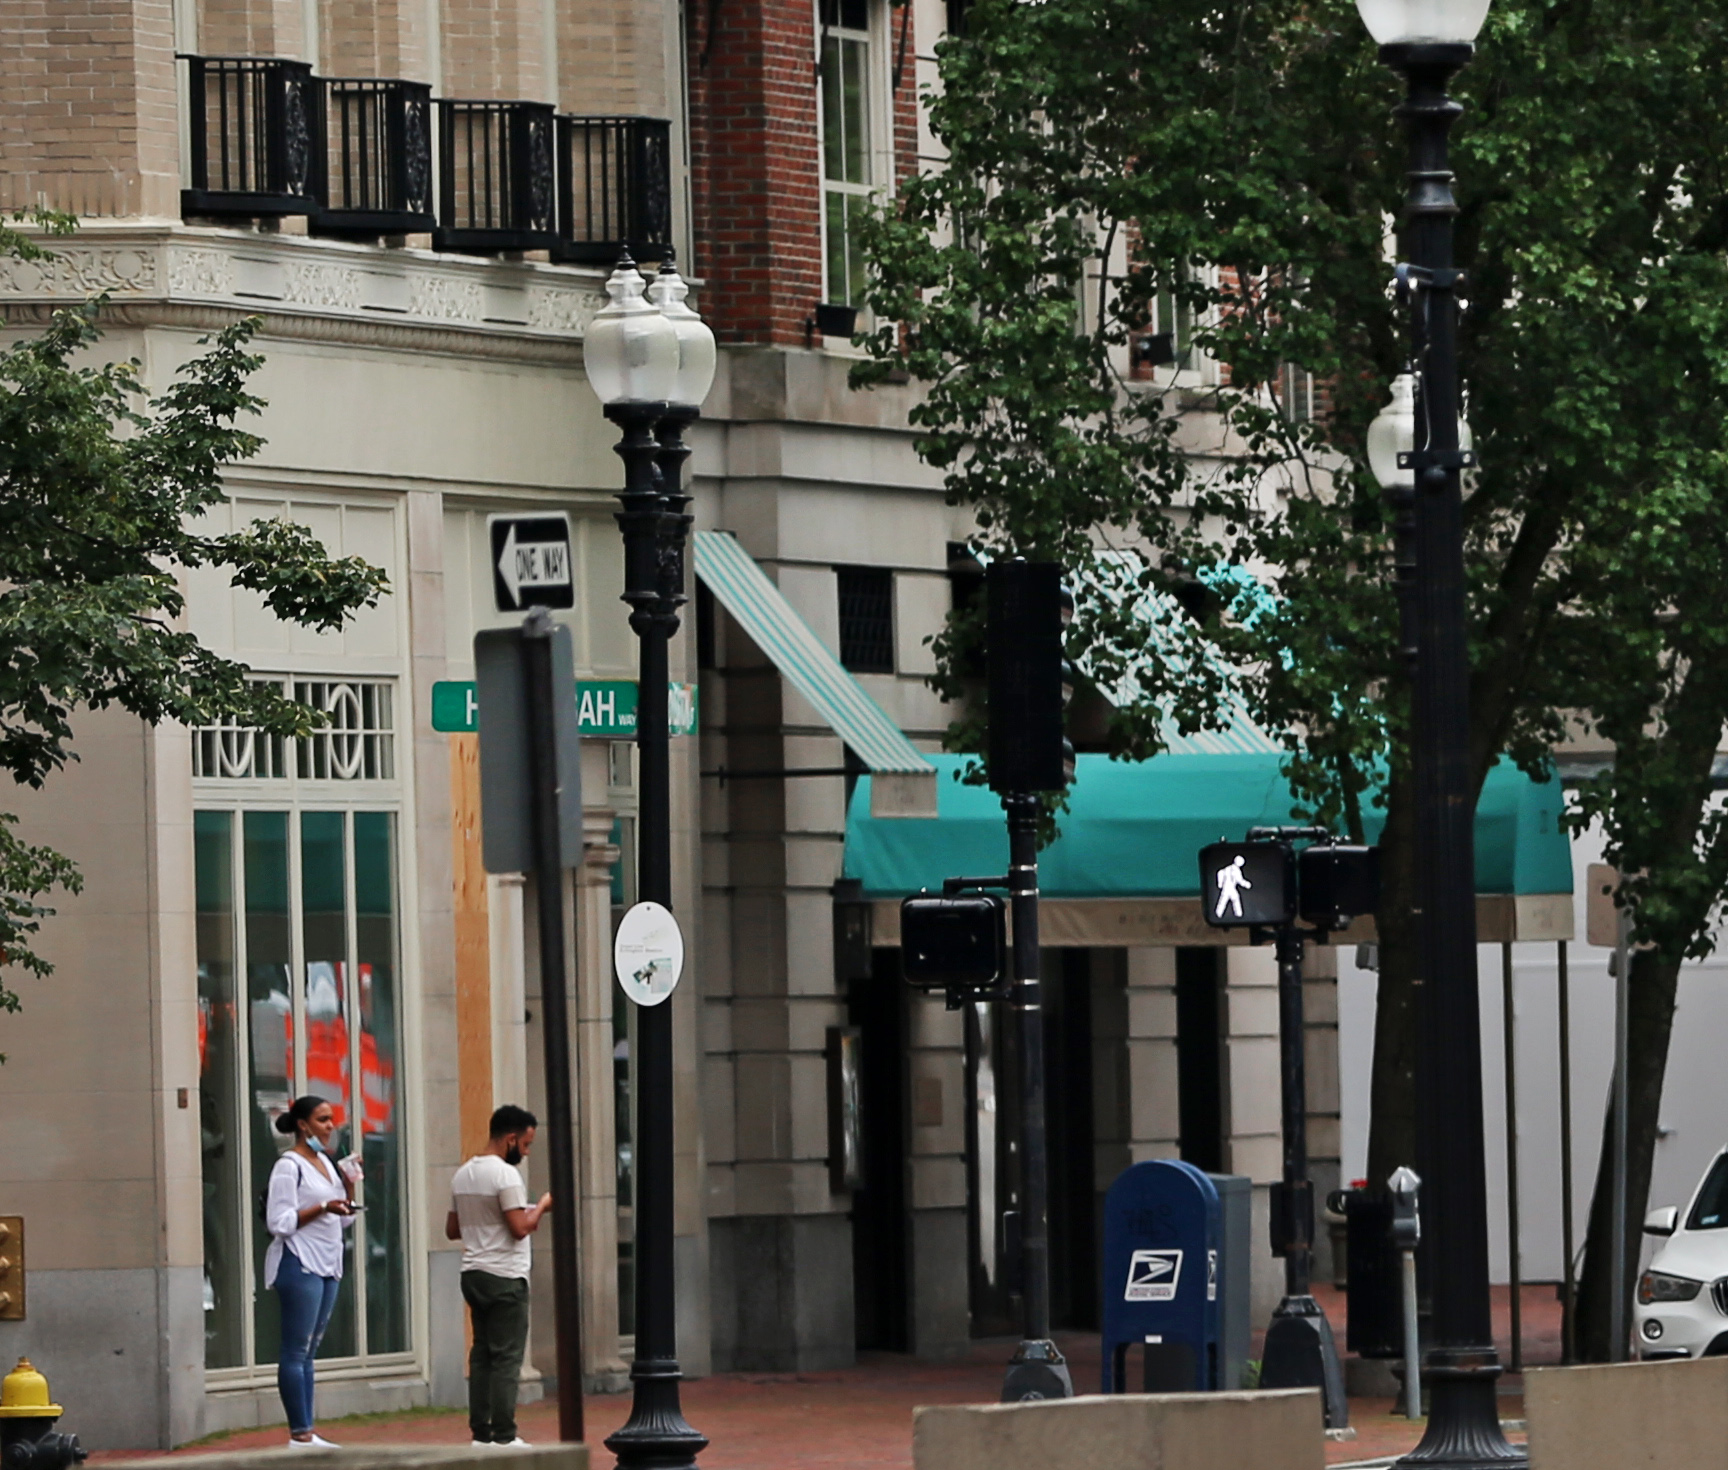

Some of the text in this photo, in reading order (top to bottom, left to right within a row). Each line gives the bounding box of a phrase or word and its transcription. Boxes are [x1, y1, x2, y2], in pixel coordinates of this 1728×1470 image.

[516, 547, 563, 581] ONE WAY
[618, 713, 637, 726] WAY
